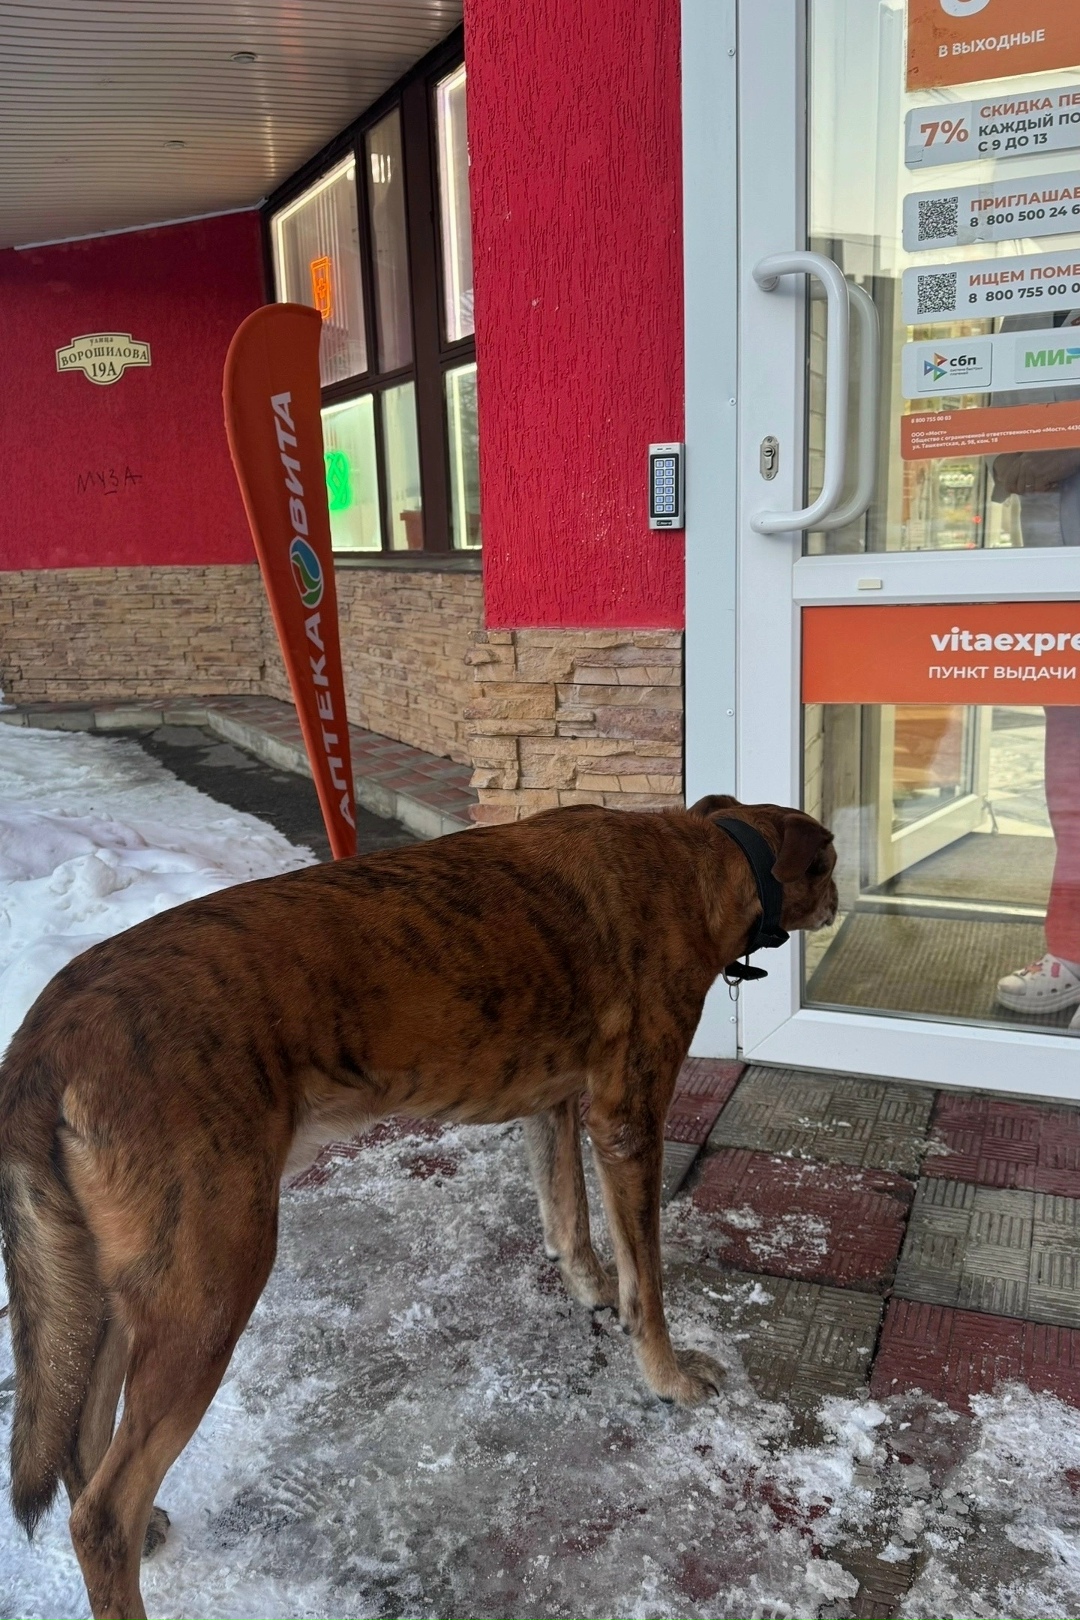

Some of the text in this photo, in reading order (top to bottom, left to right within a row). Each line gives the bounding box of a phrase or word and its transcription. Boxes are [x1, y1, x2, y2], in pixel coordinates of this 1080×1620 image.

[939, 28, 1046, 58] В ВЫХОДНЫЕ
[980, 97, 1053, 119] СКИДКА
[920, 118, 969, 148] 7%
[978, 111, 1080, 137] КАЖДЫЙ ПО
[978, 132, 1048, 152] С 9 ДО 13
[970, 186, 1080, 212] ПРИГЛАШАЕ
[970, 216, 979, 227] 8
[986, 212, 1014, 226] 800
[1018, 208, 1045, 222] 500
[1049, 205, 1068, 218] 24
[969, 269, 1025, 287] ИЩЕМ
[968, 292, 977, 303] 8
[985, 289, 1014, 302] 800
[1018, 286, 1043, 299] 755
[1047, 283, 1067, 296] 00
[90, 336, 113, 346] улица
[61, 346, 147, 366] ВОРОШИЛОВА
[949, 354, 977, 367] сбп
[91, 361, 117, 377] 19А
[270, 391, 356, 830] АПТЕКА ВИТА
[928, 666, 1076, 682] ПУНКТ ВЫДАЧИ
